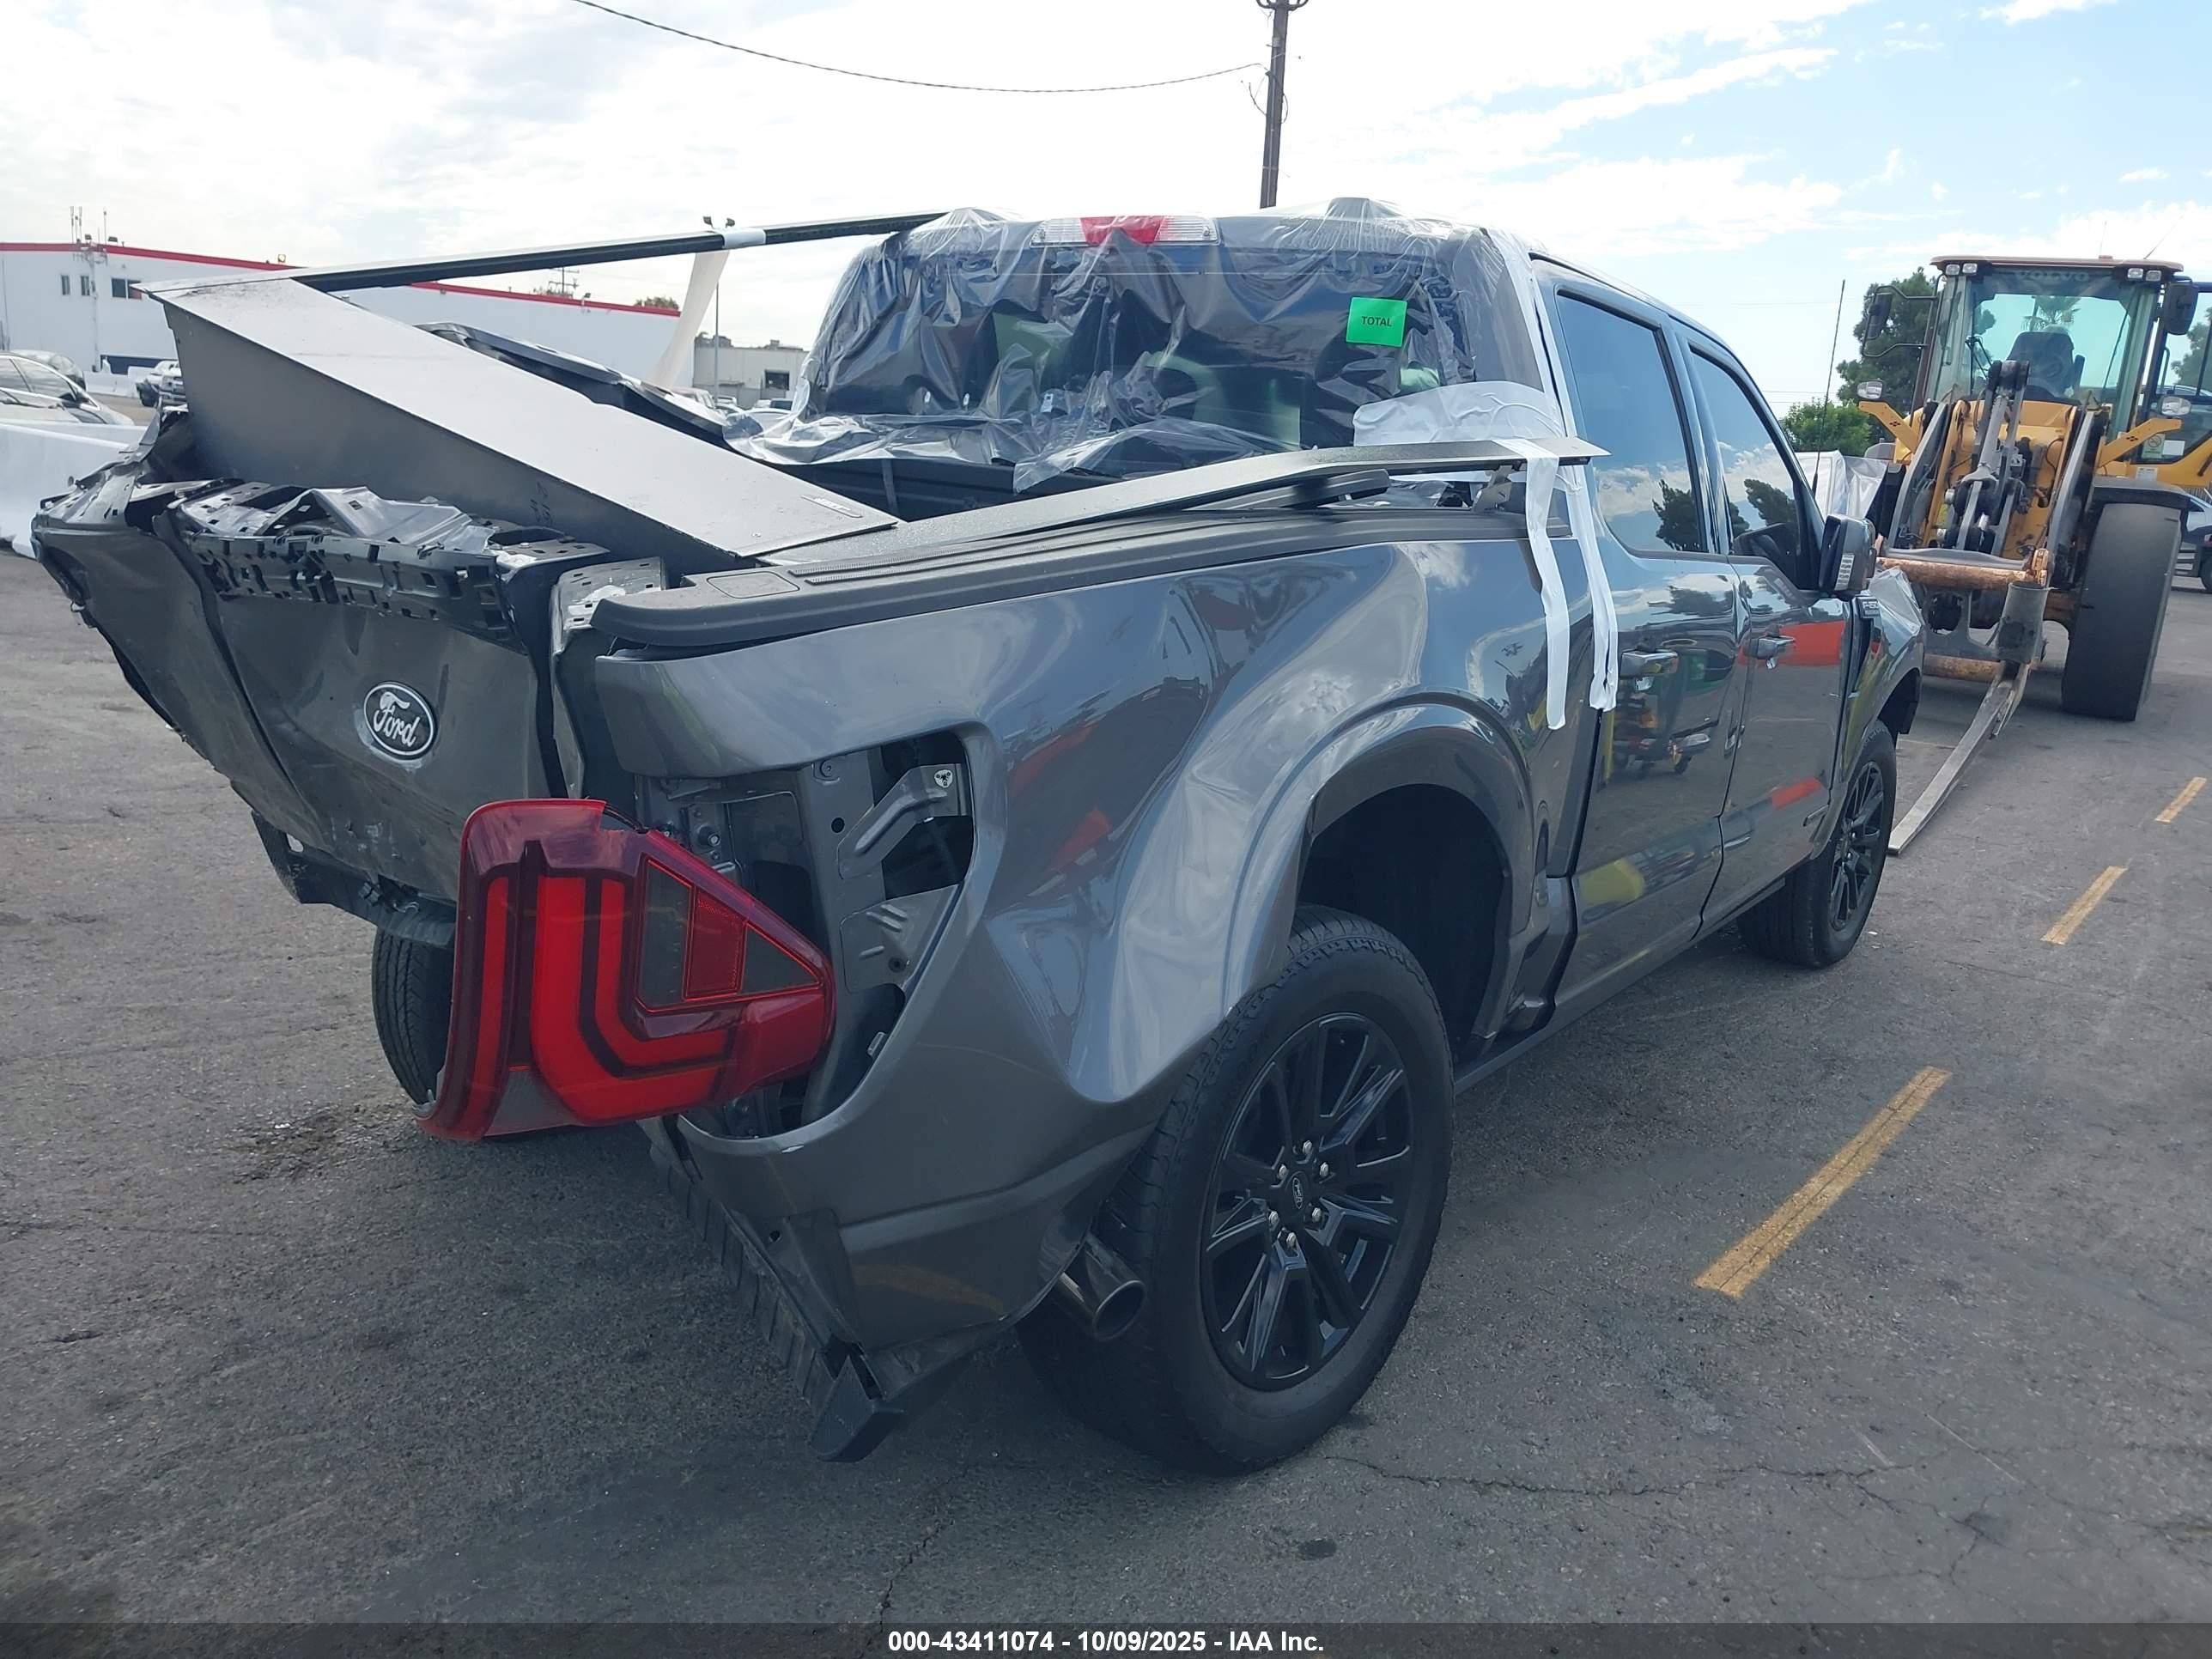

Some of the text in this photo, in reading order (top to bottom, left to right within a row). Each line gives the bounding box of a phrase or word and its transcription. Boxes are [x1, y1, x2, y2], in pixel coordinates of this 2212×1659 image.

[2014, 270, 2089, 282] VOLVO
[1361, 316, 1392, 326] TOTAL
[373, 691, 421, 747] Ford
